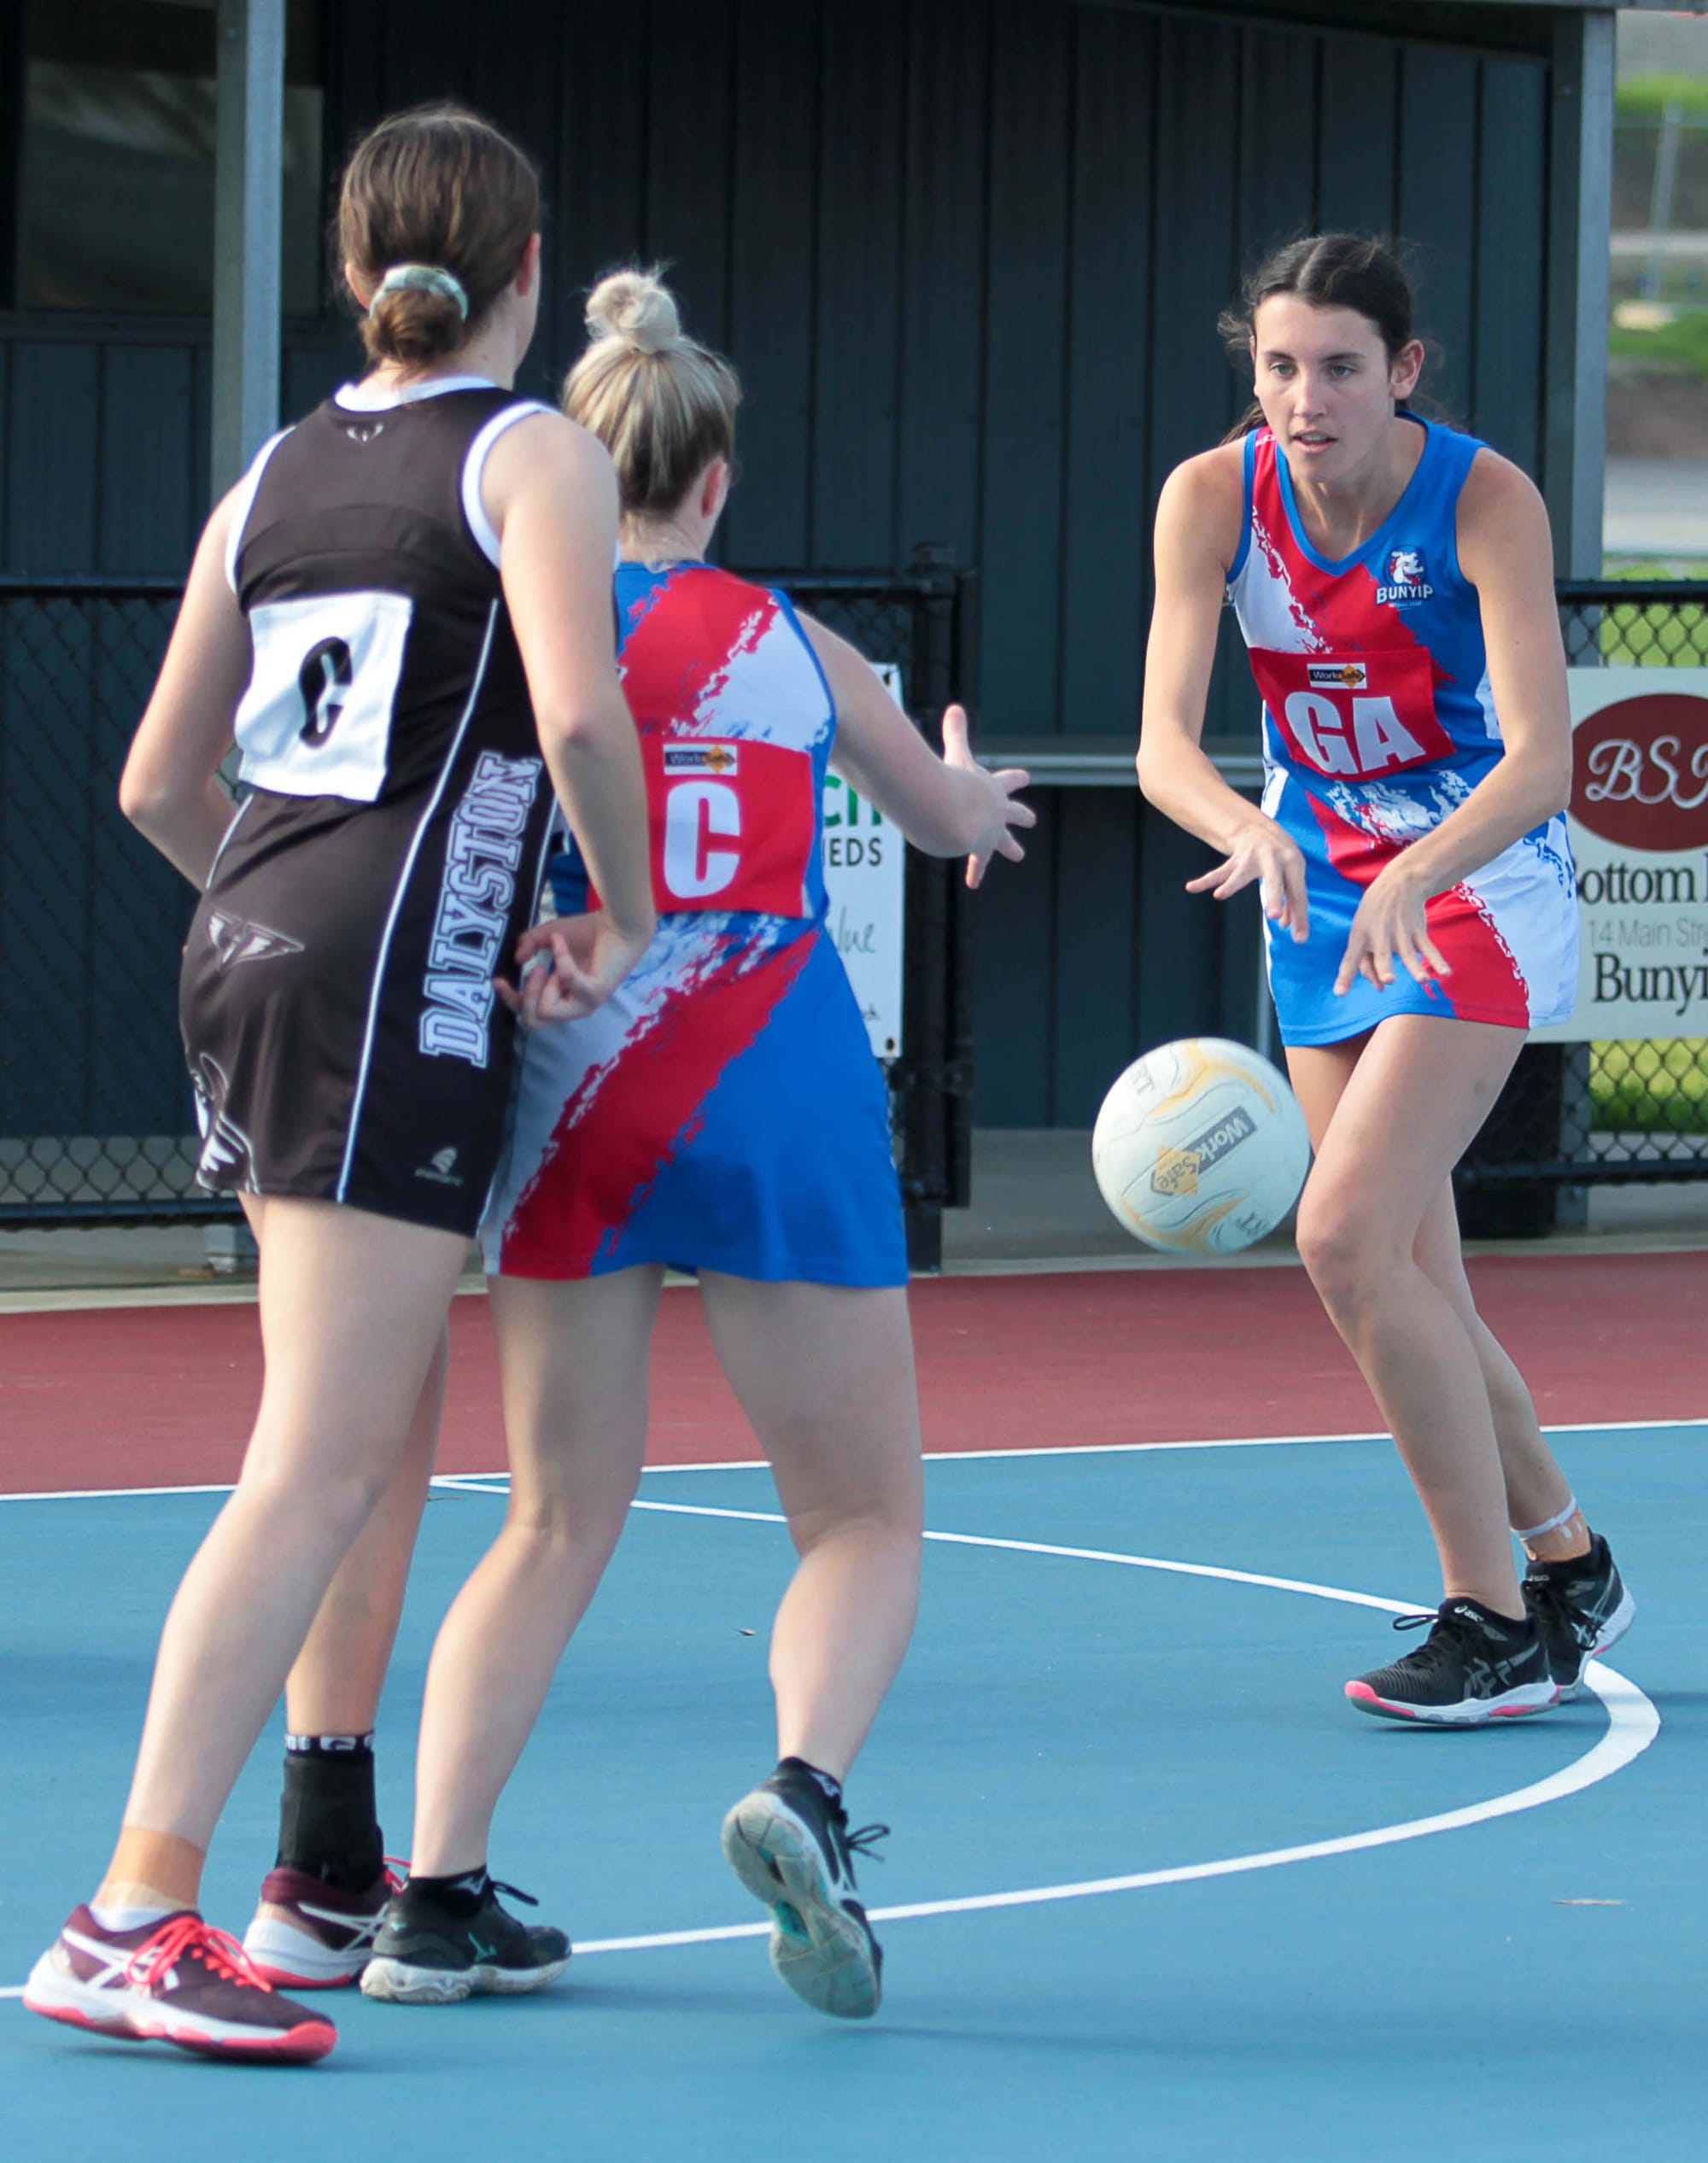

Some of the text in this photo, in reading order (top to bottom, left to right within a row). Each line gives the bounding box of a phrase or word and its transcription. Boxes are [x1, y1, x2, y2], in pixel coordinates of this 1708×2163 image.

[1377, 583, 1433, 605] BUNYIP
[1284, 692, 1427, 775] GA
[664, 780, 741, 899] C
[822, 837, 882, 867] EDS
[419, 751, 543, 1068] DALYSTON
[1574, 858, 1696, 905] ottom
[1619, 919, 1671, 948] Main
[1155, 1115, 1251, 1190] WorkSafe
